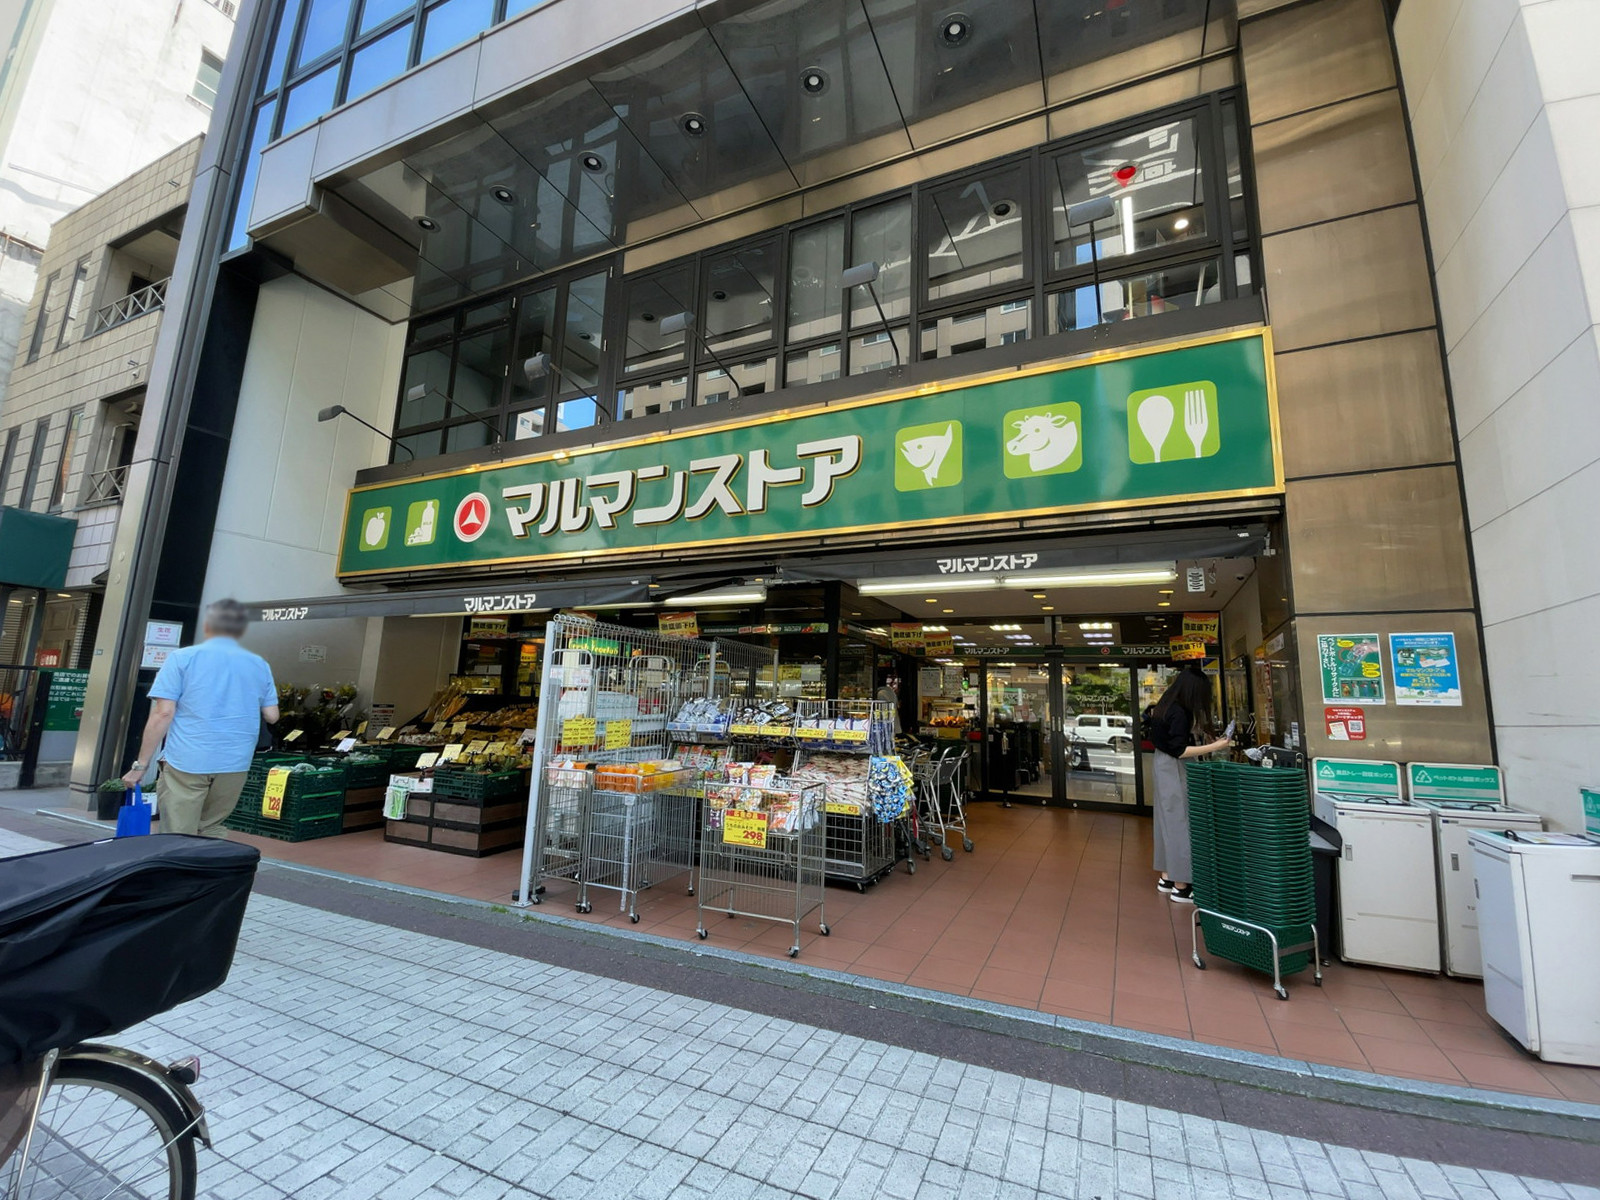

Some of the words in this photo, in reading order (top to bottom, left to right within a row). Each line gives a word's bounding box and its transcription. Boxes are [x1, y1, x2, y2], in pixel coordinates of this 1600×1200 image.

[502, 435, 862, 538] マルマンストア
[937, 553, 1038, 574] マルマンストア
[463, 593, 537, 612] マルマンストア
[261, 607, 309, 621] マルマンストア
[1184, 623, 1216, 632] 徹底値下げ
[893, 631, 922, 639] 徹底値下げ
[964, 647, 1010, 655] マルマンストア
[1121, 647, 1171, 655] マルマンスト
[1171, 642, 1203, 652] 徹底値下げ
[268, 796, 281, 812] 128
[742, 829, 763, 841] 298
